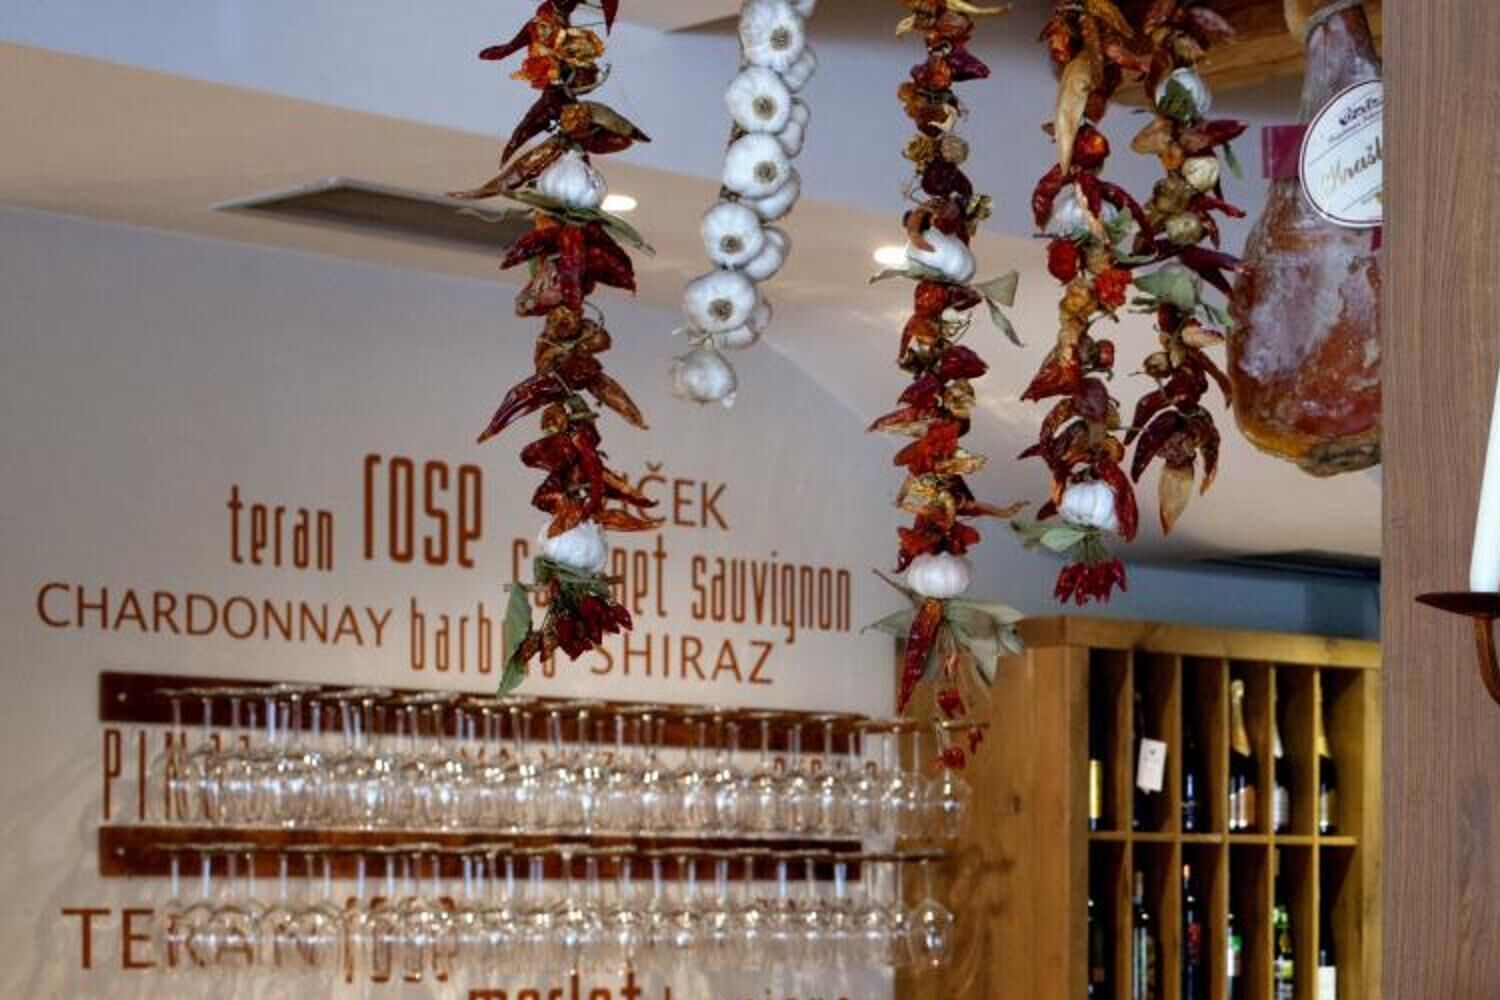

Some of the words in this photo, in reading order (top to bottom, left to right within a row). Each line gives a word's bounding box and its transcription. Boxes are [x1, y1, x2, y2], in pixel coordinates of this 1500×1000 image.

[227, 485, 336, 572] teran
[363, 453, 484, 569] rose
[36, 582, 393, 648] CHARDONNAY
[690, 550, 852, 644] sauvignon
[591, 633, 775, 685] SHIRAZ
